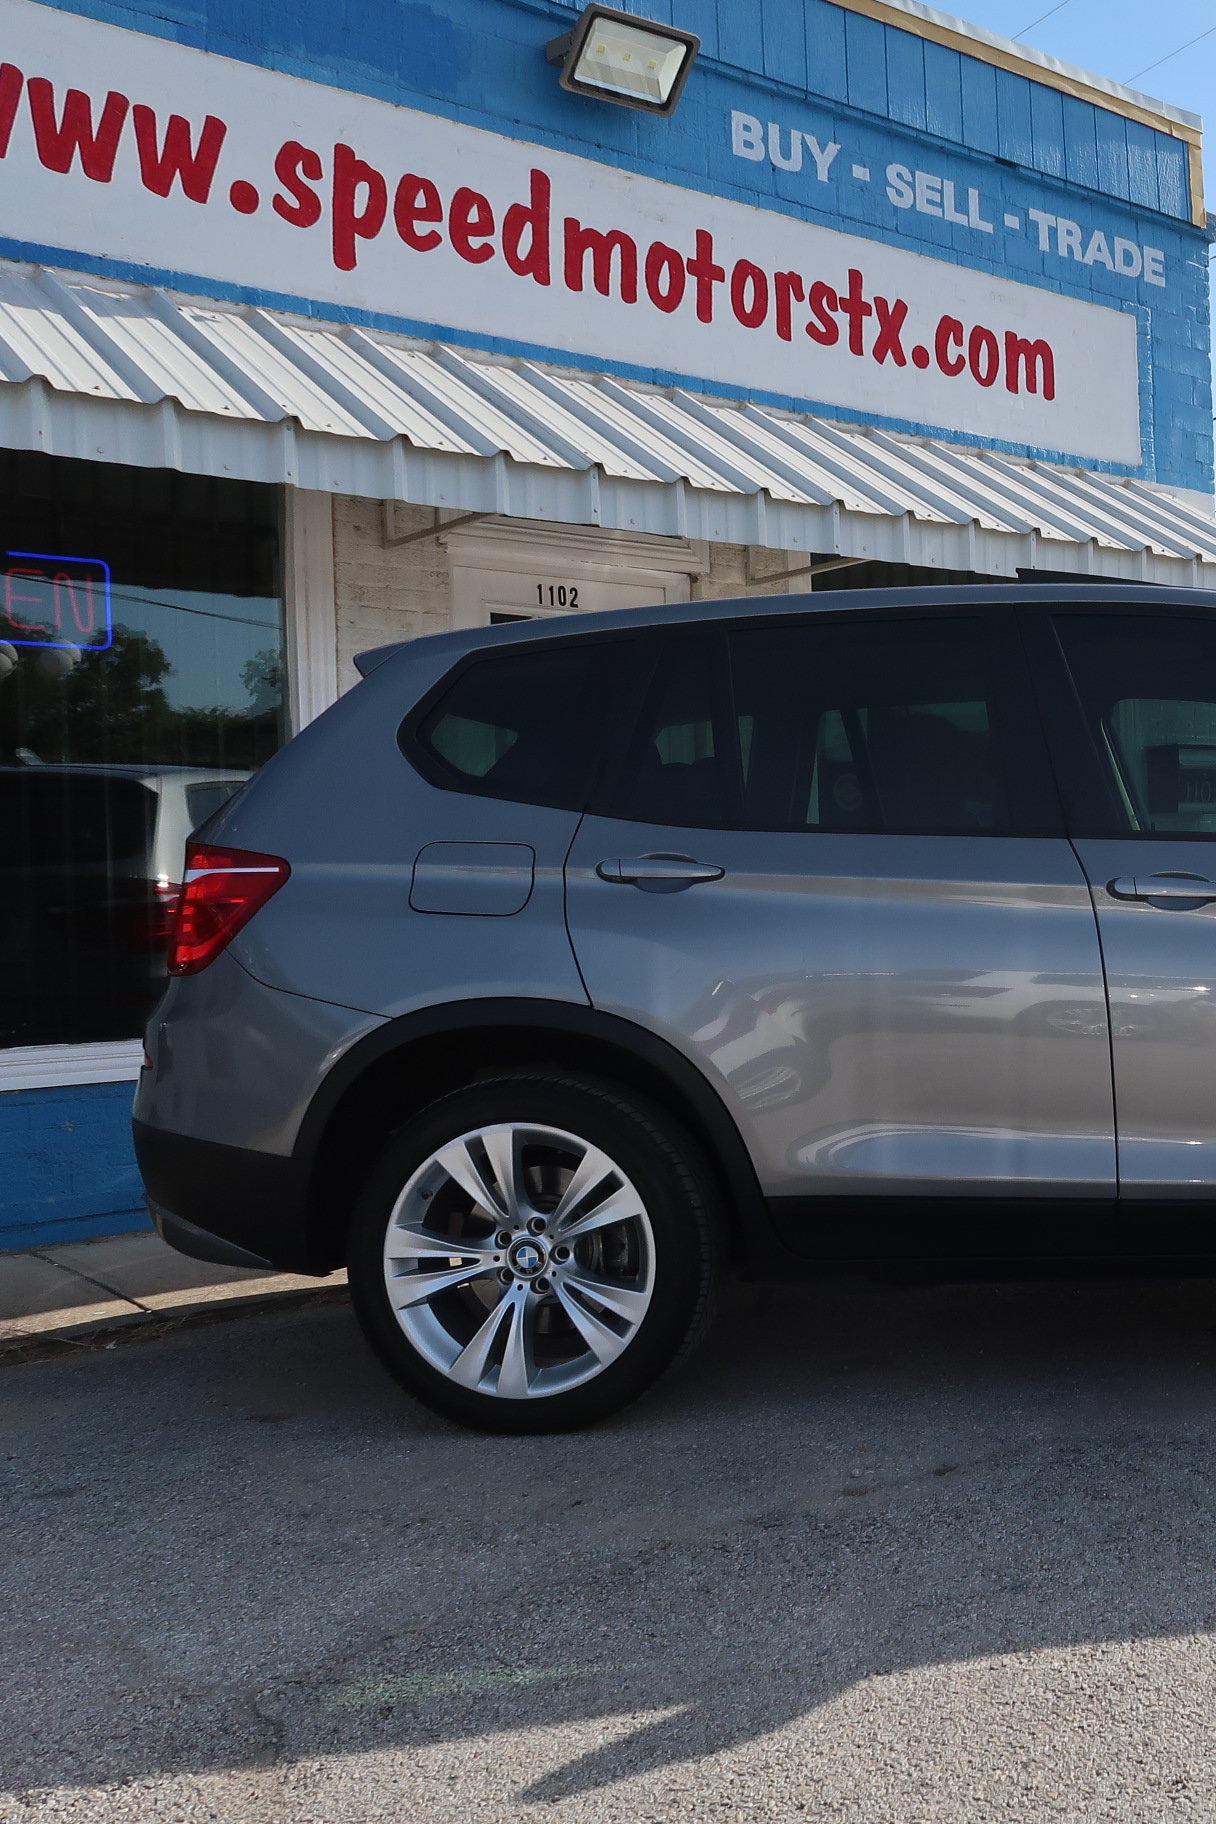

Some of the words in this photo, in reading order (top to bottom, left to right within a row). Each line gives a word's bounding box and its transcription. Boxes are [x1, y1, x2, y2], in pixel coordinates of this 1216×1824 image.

[0, 62, 1055, 401] ww.speedmotorstx.com
[731, 110, 841, 183] BUY
[886, 163, 994, 234] SELL
[1029, 207, 1166, 288] TRADE
[536, 583, 579, 608] 1102
